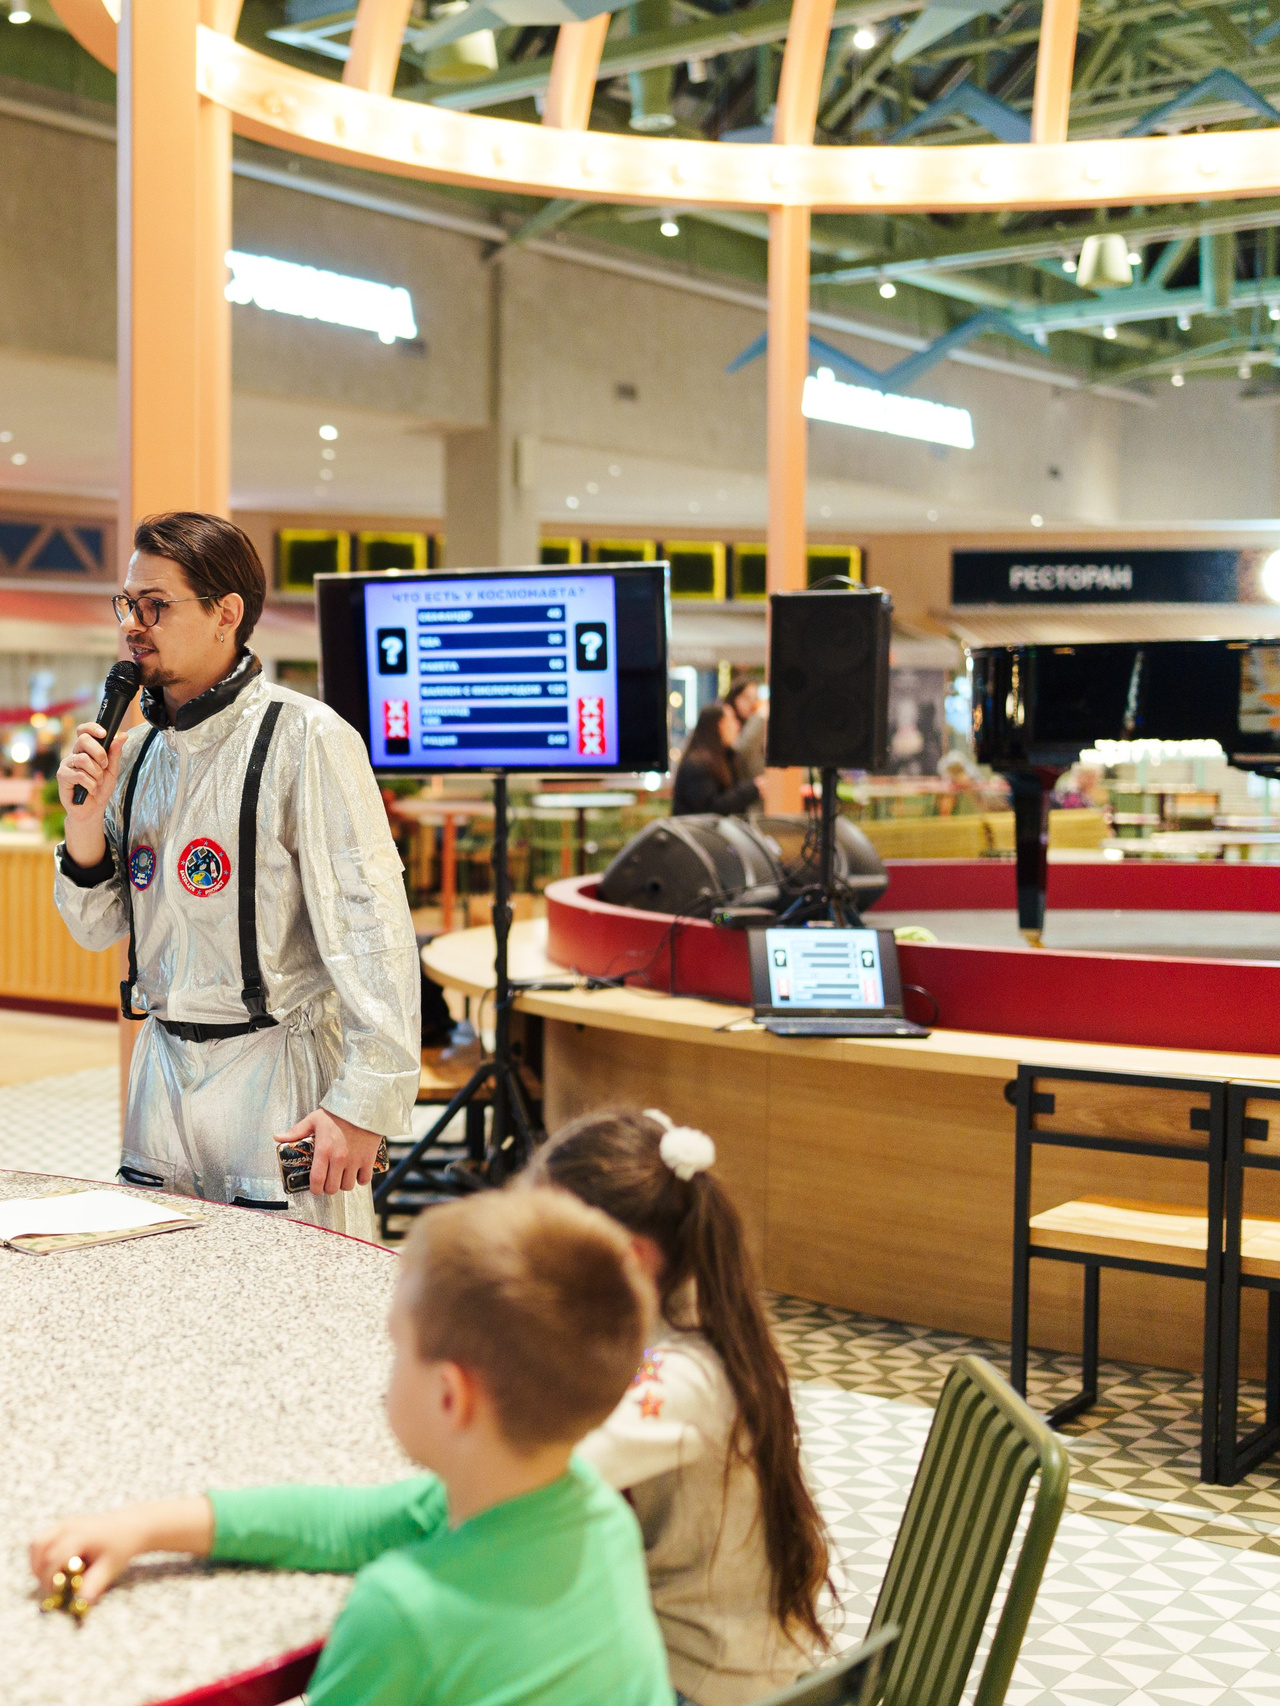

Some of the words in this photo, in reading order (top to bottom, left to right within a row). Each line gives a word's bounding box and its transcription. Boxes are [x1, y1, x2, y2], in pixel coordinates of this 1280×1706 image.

[1009, 564, 1133, 591] РЕСТОРАН
[424, 591, 460, 602] ЕСТЬ
[477, 586, 585, 601] КОСМОНАВТА?
